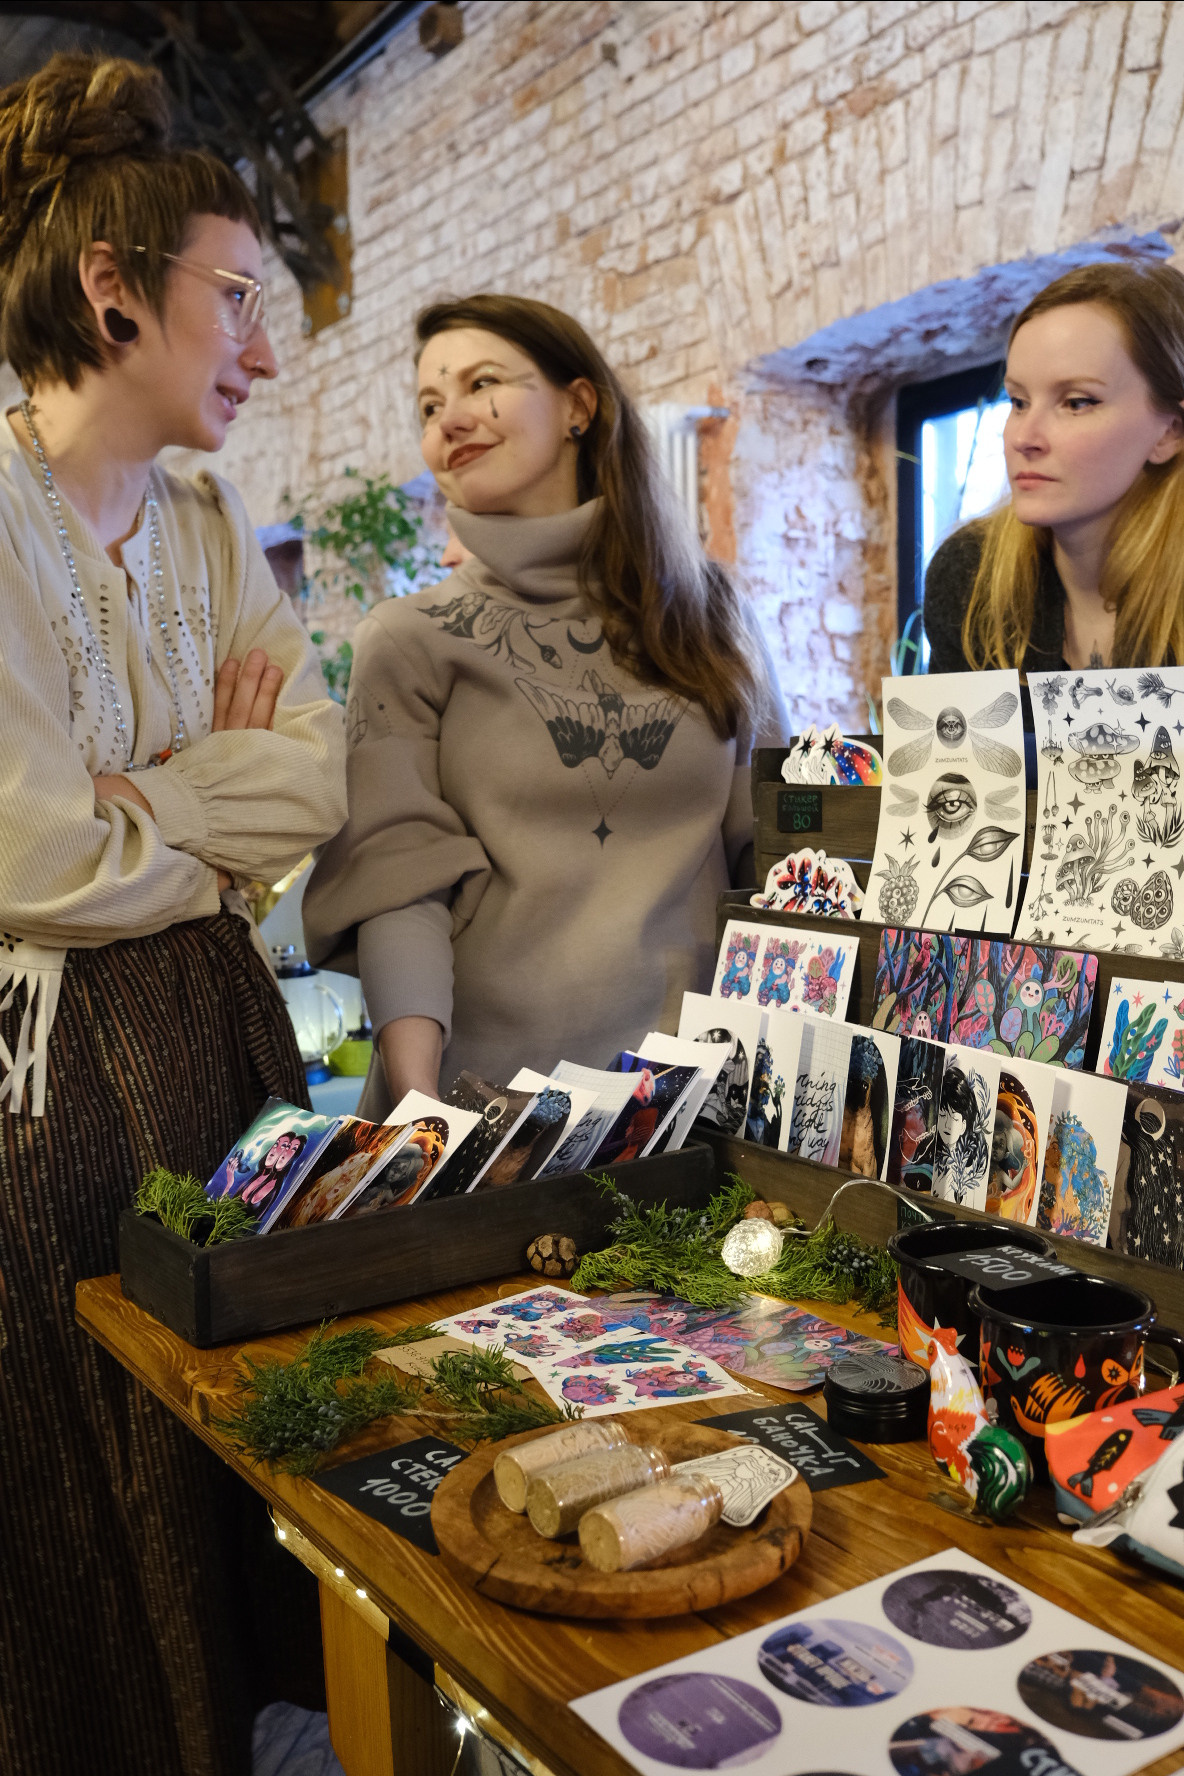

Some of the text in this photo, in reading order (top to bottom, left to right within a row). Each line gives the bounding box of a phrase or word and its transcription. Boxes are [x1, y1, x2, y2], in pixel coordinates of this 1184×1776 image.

[793, 813, 810, 830] 80
[1062, 916, 1104, 926] ZUMZUMTATS
[958, 1253, 1033, 1281] 1500
[425, 1450, 462, 1471] СА
[752, 1416, 836, 1477] БАНОЧКА
[391, 1458, 445, 1493] СТЕК
[359, 1478, 432, 1517] 1000
